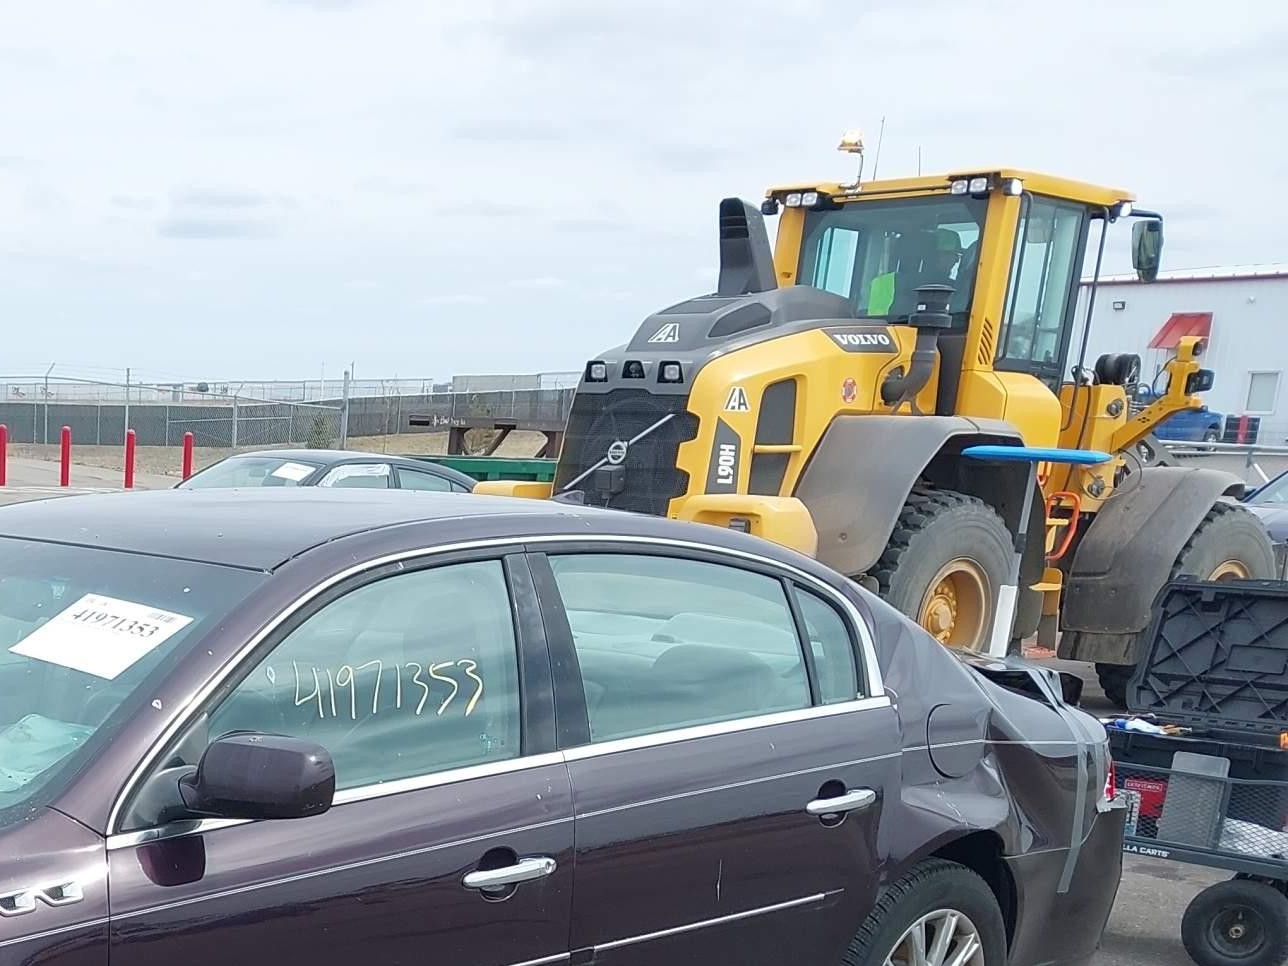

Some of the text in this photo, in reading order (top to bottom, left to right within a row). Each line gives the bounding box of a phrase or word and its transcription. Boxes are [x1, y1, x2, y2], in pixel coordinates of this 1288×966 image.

[833, 334, 890, 345] VOLVO
[716, 444, 736, 485] L90H
[72, 608, 160, 638] 41971353
[292, 659, 484, 720] 41971353
[1140, 847, 1169, 857] CARTS
